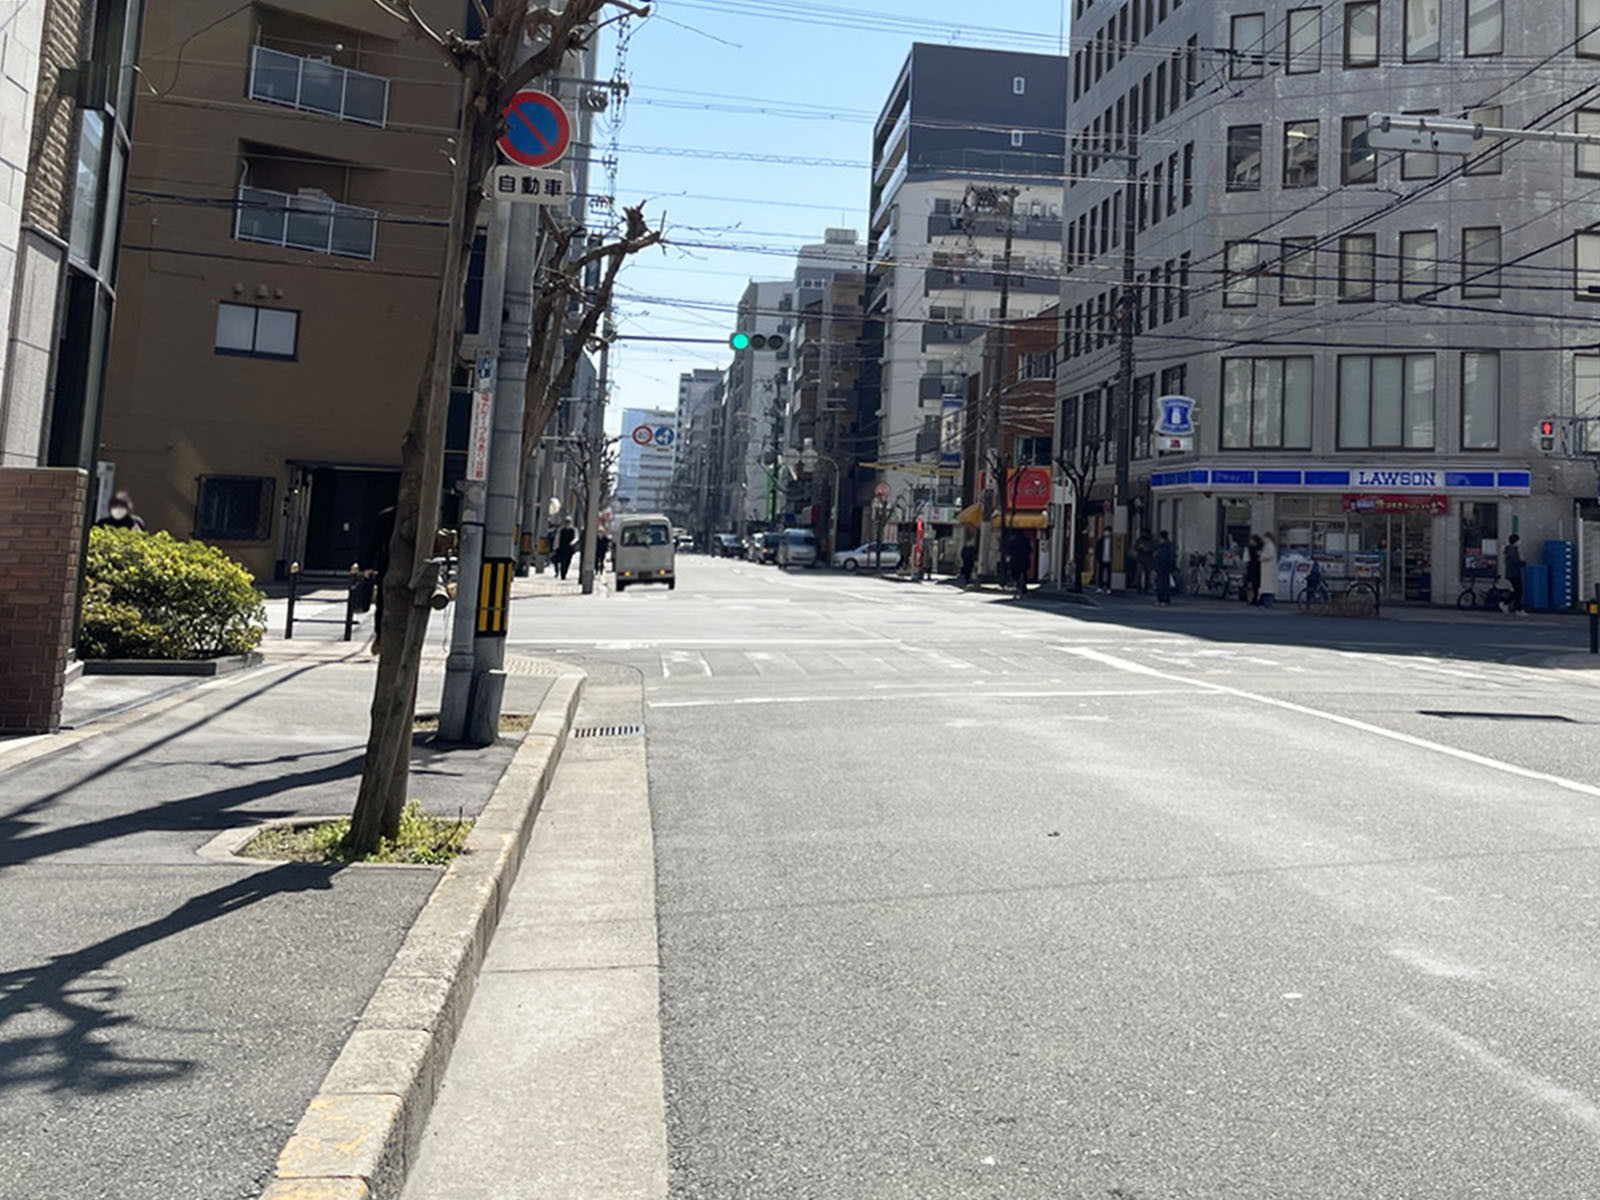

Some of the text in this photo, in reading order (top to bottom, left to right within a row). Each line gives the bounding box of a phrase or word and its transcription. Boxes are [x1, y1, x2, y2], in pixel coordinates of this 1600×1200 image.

[499, 174, 562, 196] 自動車
[1359, 471, 1436, 486] LAWSON
